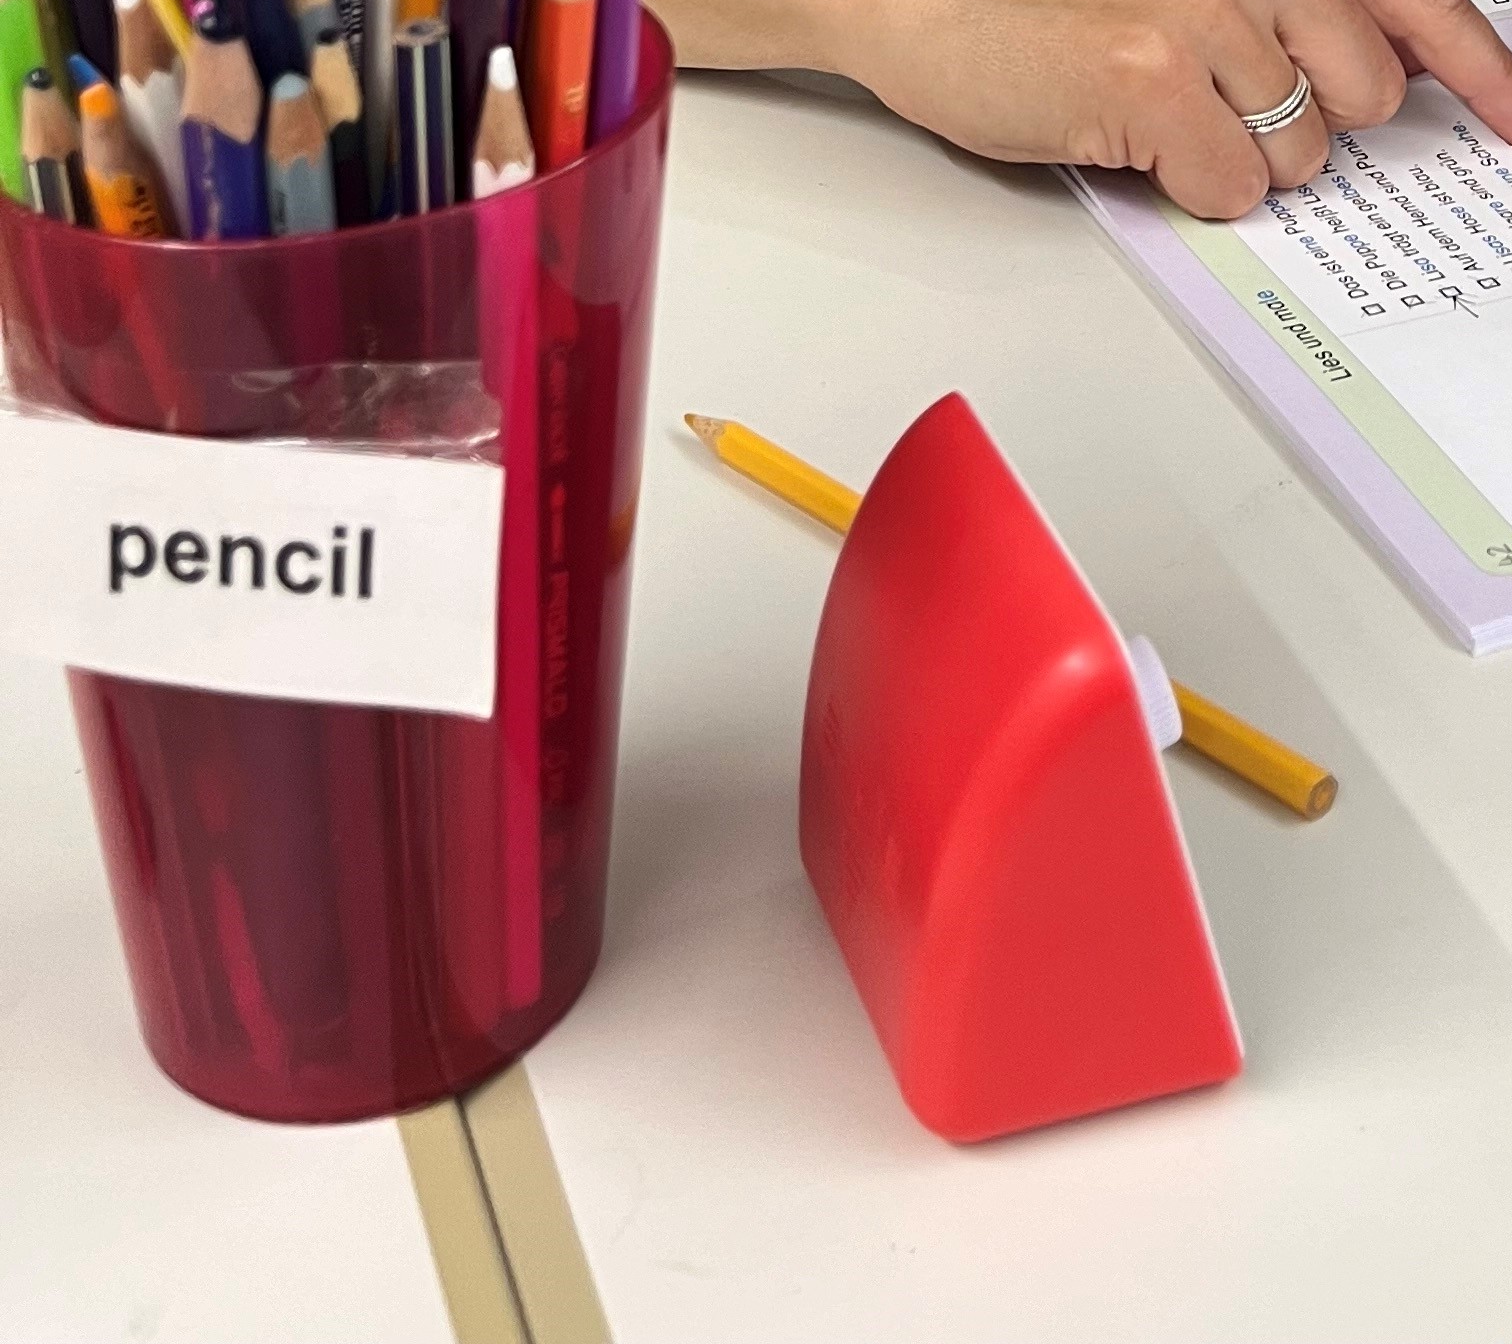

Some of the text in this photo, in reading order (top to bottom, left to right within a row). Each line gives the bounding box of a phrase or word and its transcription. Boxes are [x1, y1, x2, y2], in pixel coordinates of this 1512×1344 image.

[1452, 120, 1499, 167] Schuhe.
[1408, 163, 1441, 193] blau.
[1436, 148, 1474, 179] grün.
[1367, 169, 1399, 195] sind
[1463, 178, 1494, 201] sind
[1392, 194, 1431, 228] Hemd
[1437, 190, 1455, 207] ist
[1312, 203, 1349, 235] heißt
[1331, 173, 1446, 282] Lisa trägt ein gelbes
[1449, 205, 1487, 235] Hose
[1264, 194, 1369, 299] Das ist eine Puppe.
[1344, 233, 1380, 270] Puppe
[1427, 226, 1459, 252] dem
[1455, 251, 1484, 272] Auf
[1380, 270, 1407, 291] Die
[1257, 288, 1353, 383] Lies und male
[107, 521, 376, 600] pencil
